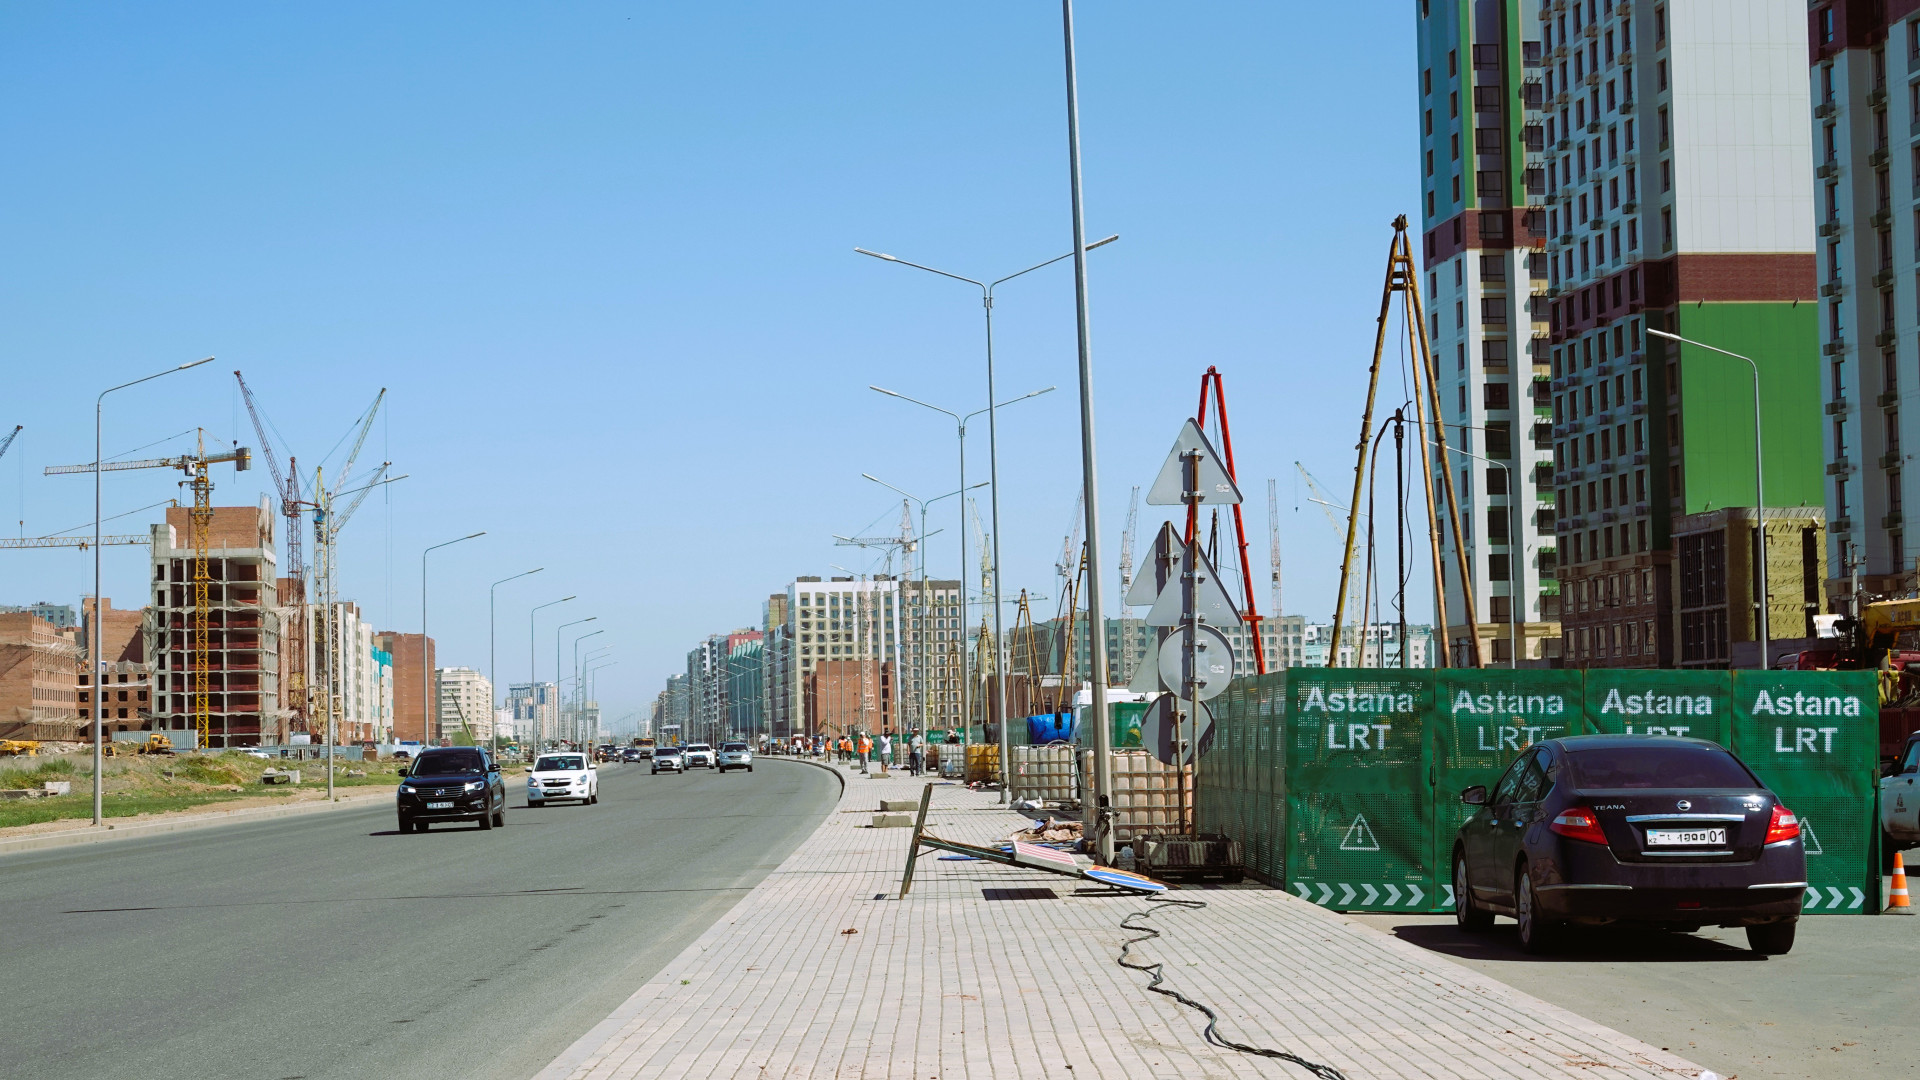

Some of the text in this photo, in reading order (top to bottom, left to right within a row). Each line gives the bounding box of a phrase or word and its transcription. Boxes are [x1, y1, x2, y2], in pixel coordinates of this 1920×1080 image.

[1303, 686, 1413, 712] Astana
[1452, 690, 1563, 714] Astana
[1601, 688, 1712, 715] Astana
[1752, 689, 1860, 716] Astana
[1328, 723, 1392, 749] LRT
[1479, 726, 1540, 750] LRT
[1775, 726, 1838, 753] LRT
[1709, 830, 1726, 843] 01
